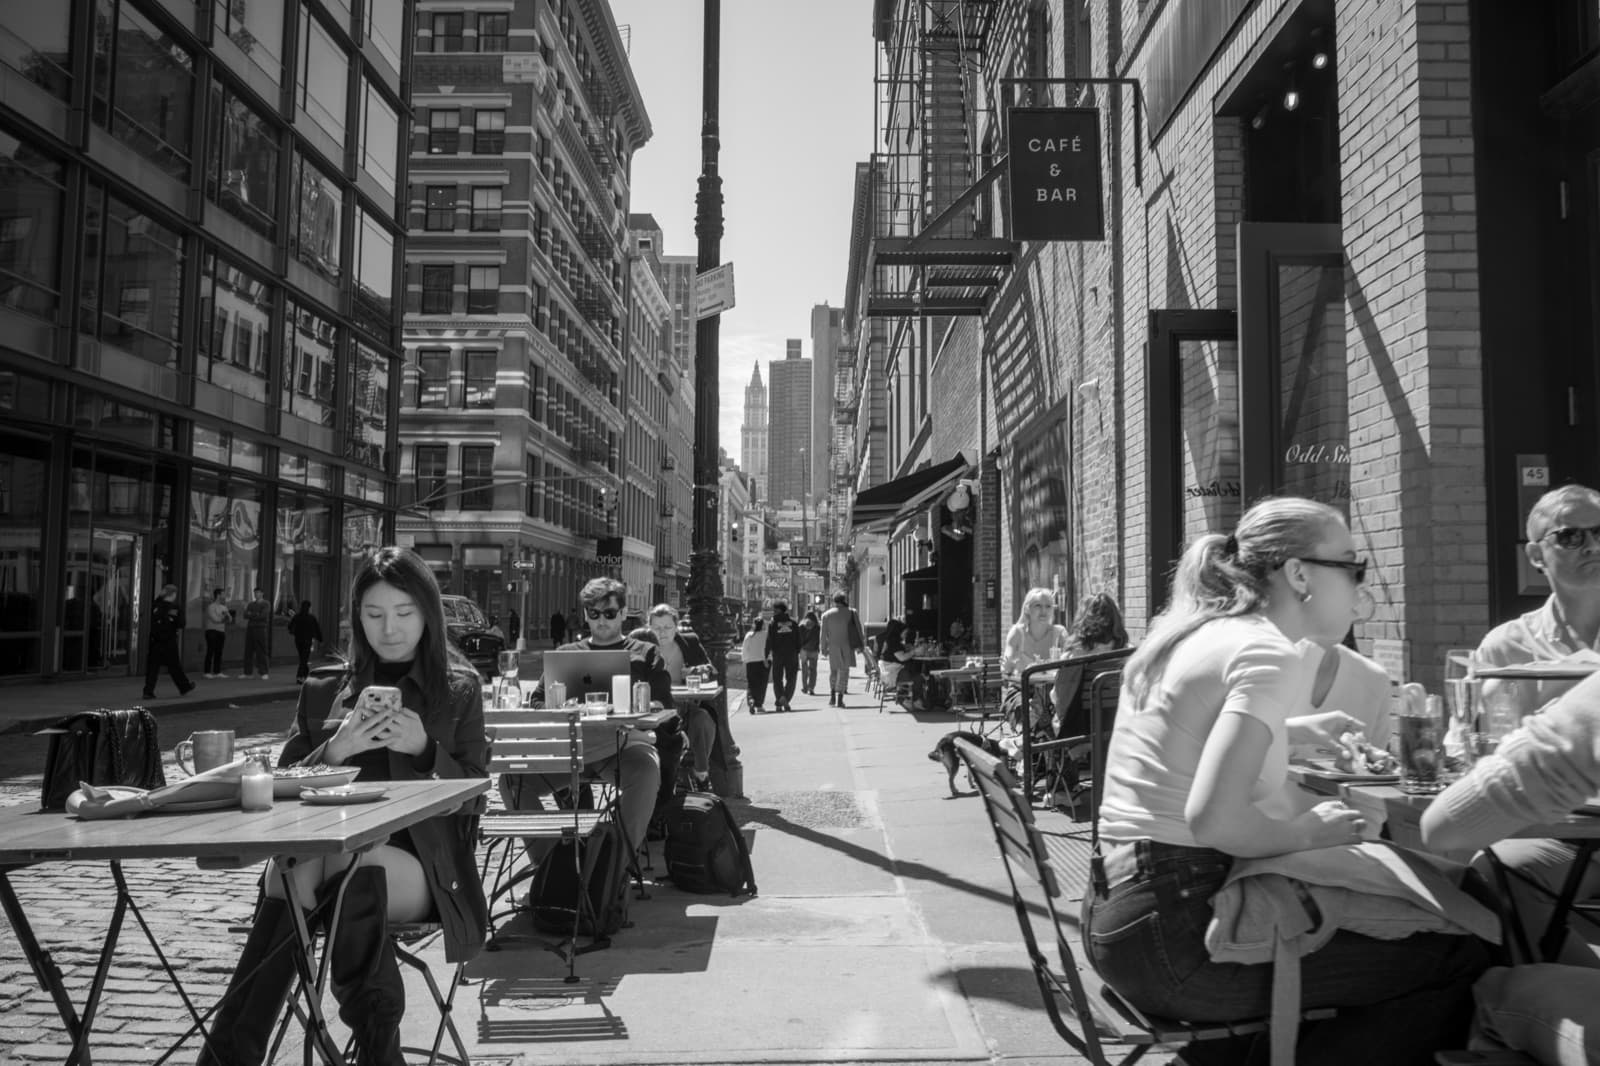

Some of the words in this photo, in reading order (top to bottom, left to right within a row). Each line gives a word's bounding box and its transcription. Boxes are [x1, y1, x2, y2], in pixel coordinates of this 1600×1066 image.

[1028, 135, 1081, 152] CAFÉ
[1049, 163, 1062, 177] &
[1036, 188, 1077, 202] BAR
[1285, 444, 1325, 464] Odd
[1526, 468, 1545, 479] 45
